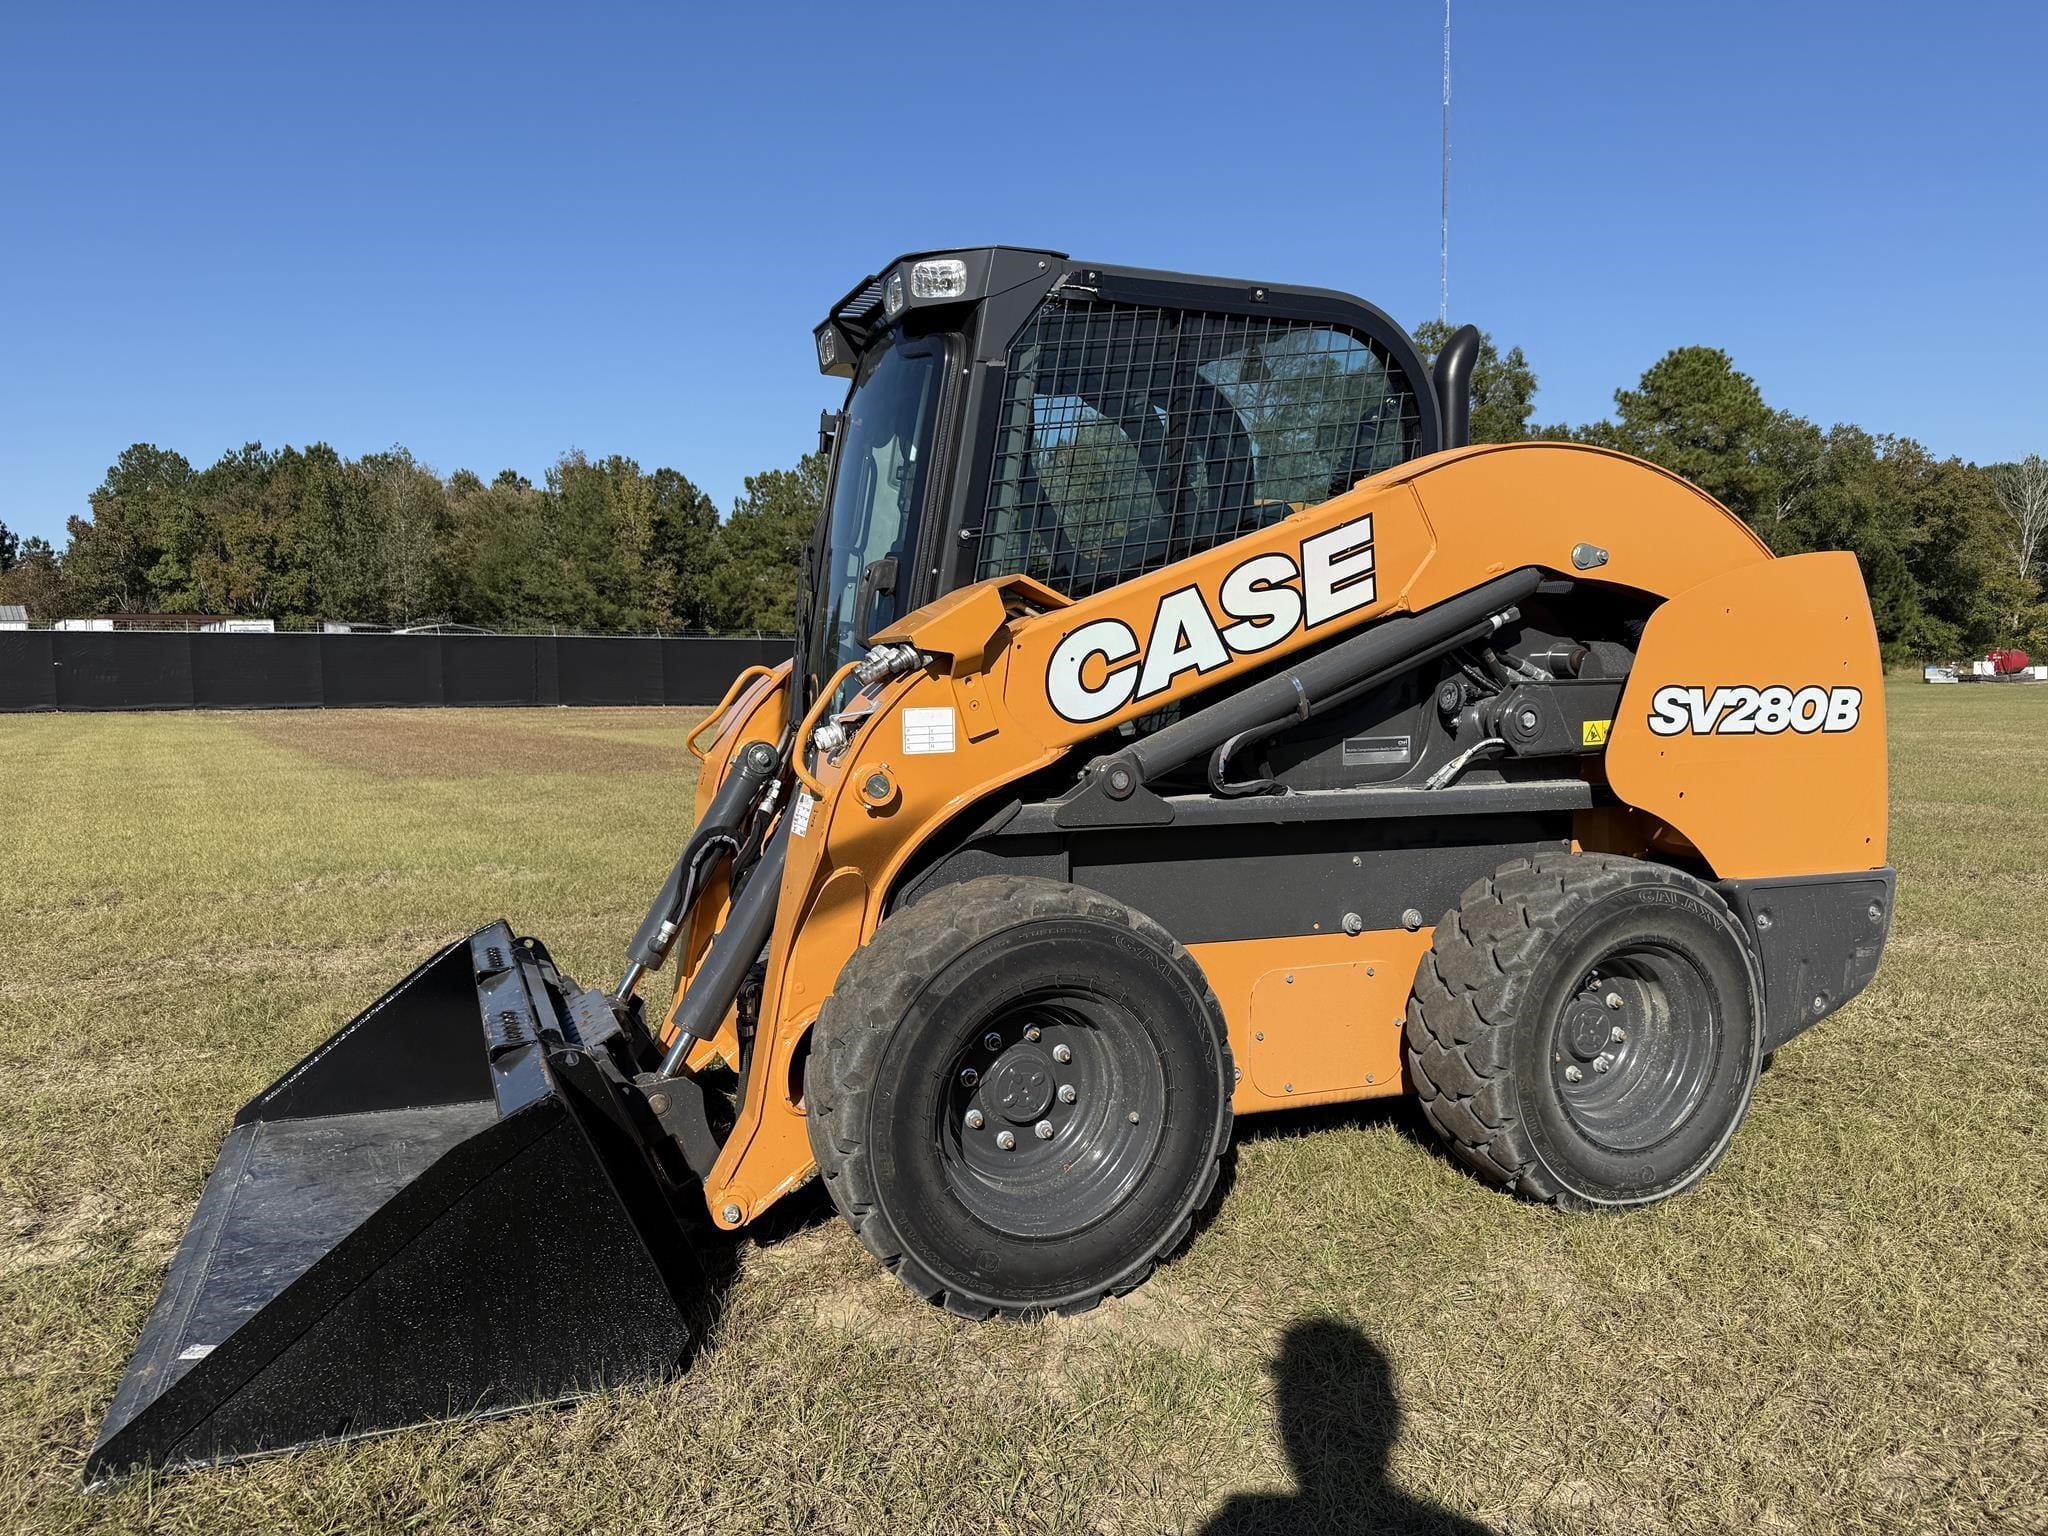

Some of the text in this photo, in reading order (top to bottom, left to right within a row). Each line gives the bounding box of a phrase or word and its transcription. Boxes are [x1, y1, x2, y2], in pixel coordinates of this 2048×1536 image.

[1045, 512, 1377, 723] CASE
[1647, 685, 1862, 736] SV280B
[1638, 890, 1724, 931] GALAXY
[1111, 936, 1217, 1071] GALAXY
